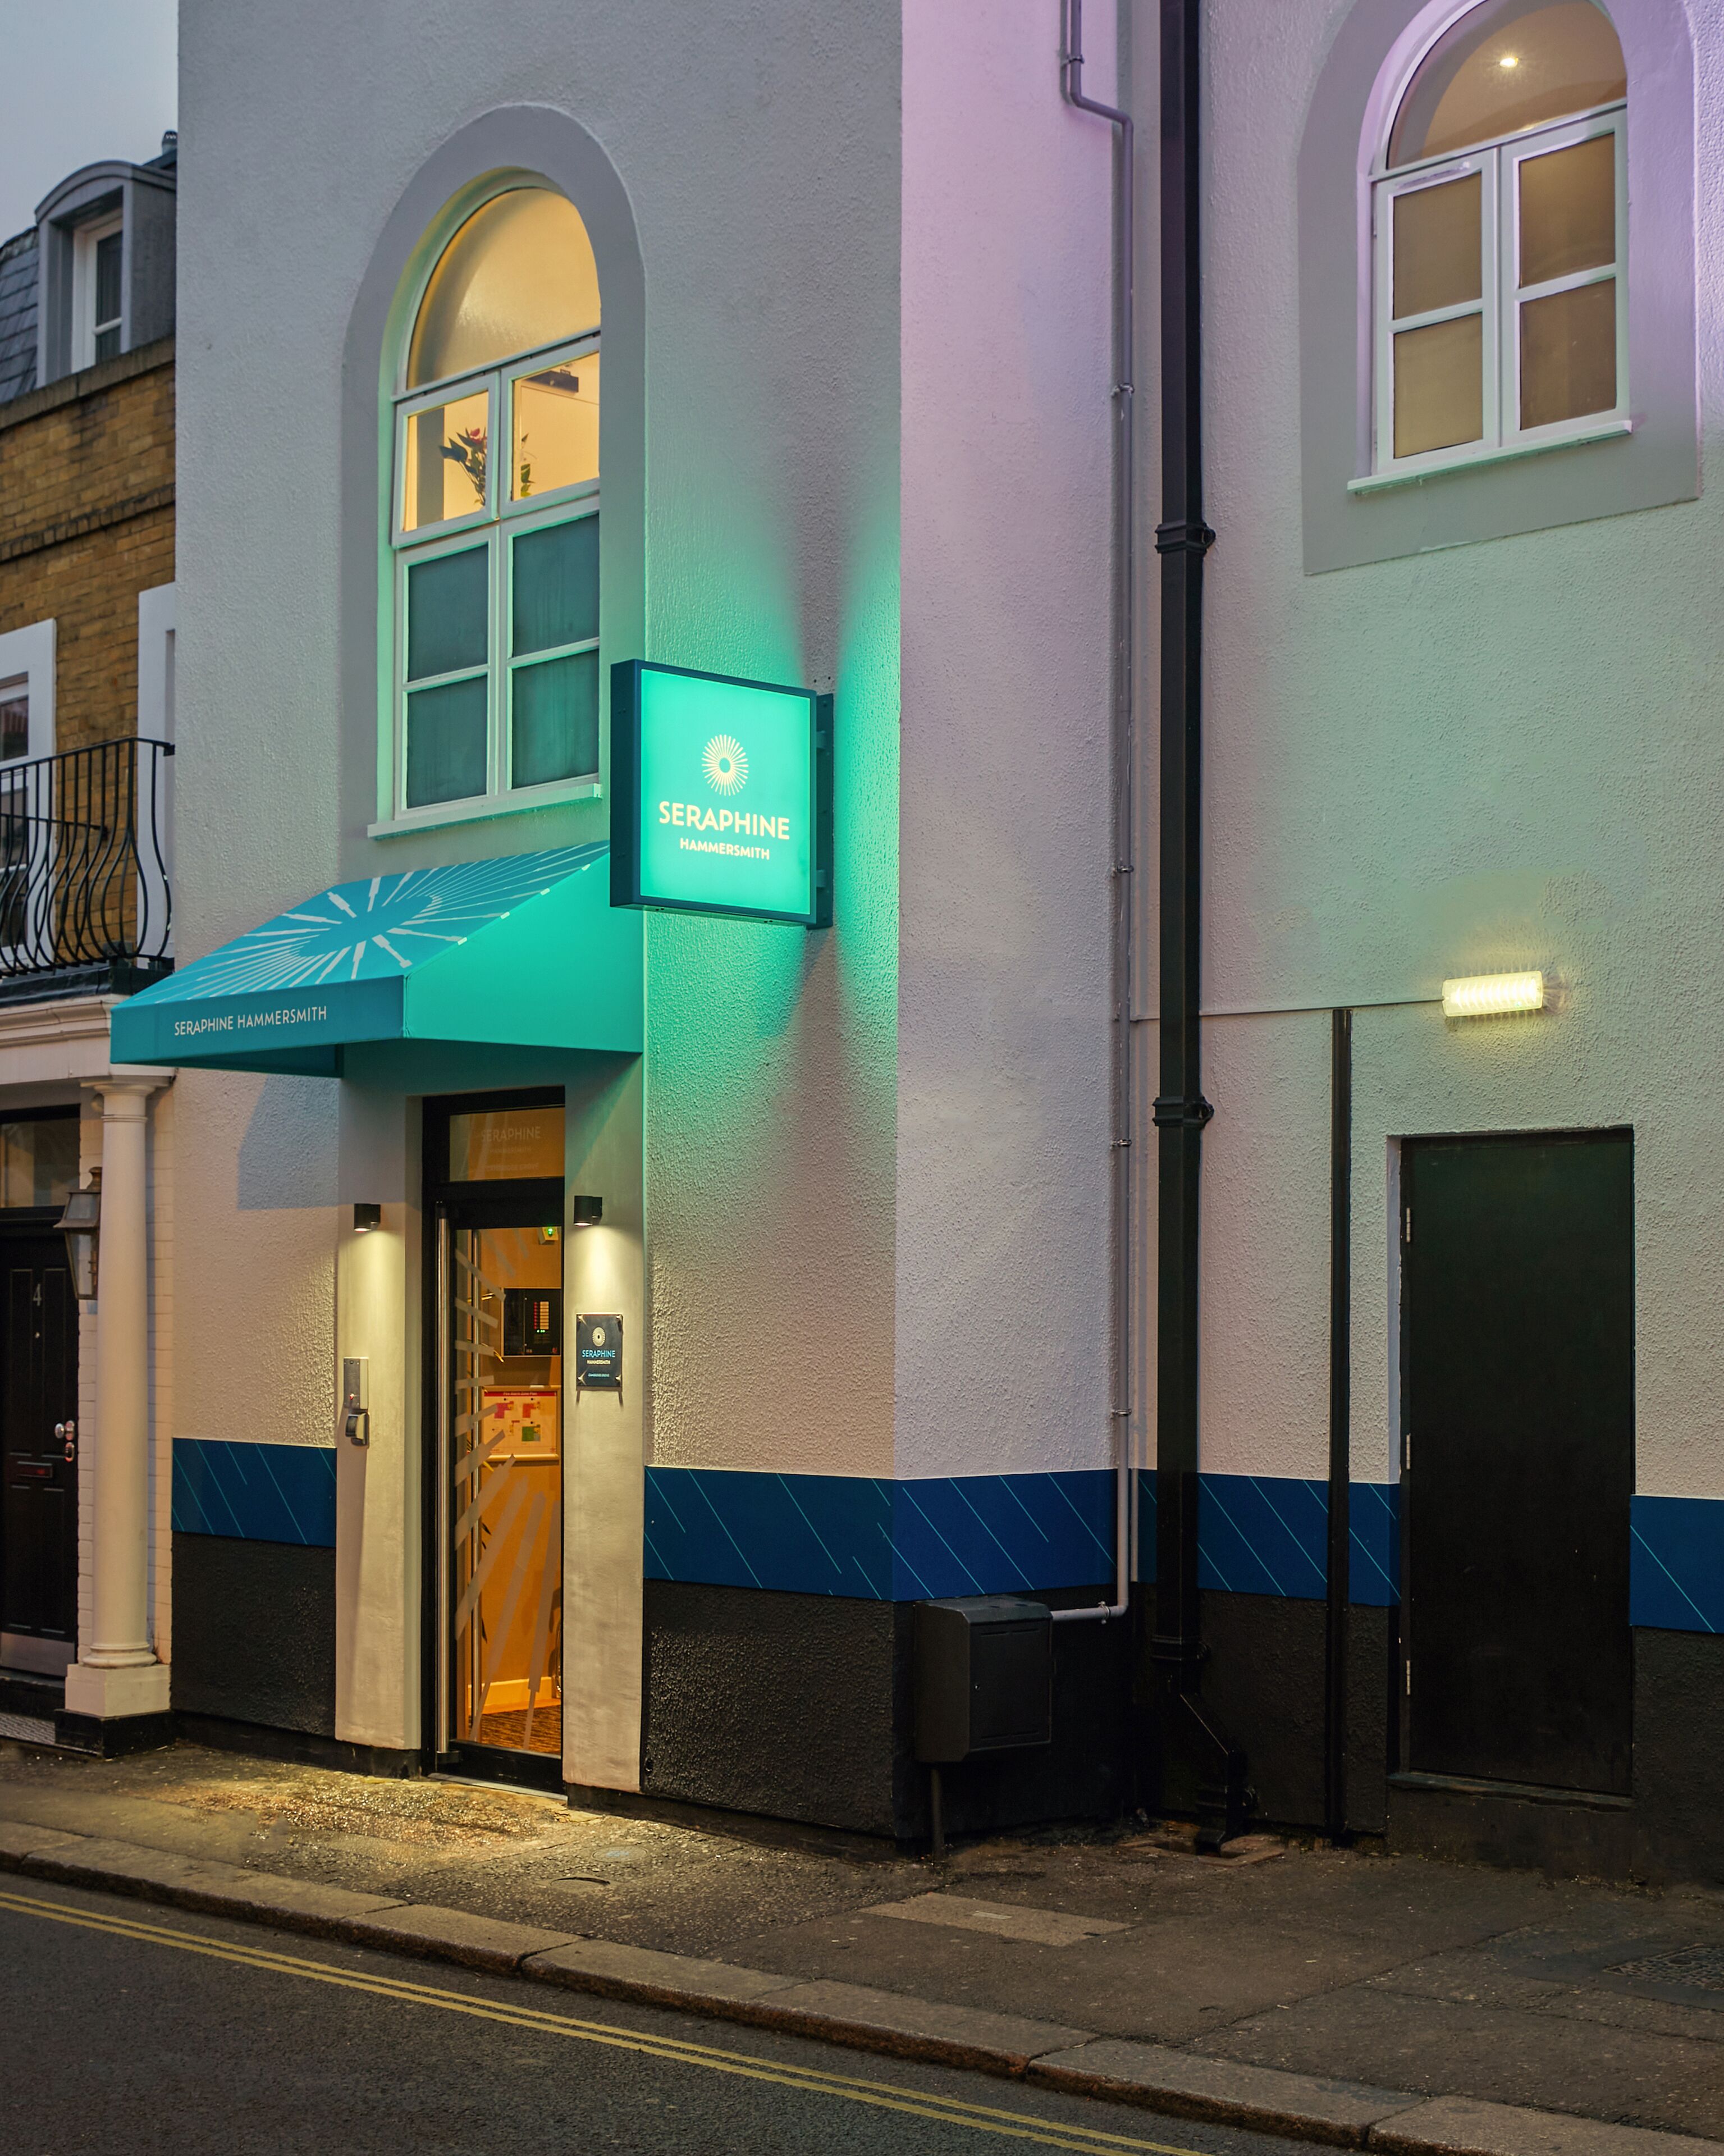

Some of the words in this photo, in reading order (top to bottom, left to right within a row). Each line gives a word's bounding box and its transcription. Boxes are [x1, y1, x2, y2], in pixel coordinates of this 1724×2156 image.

[659, 801, 790, 840] SERAPHINE
[680, 838, 770, 860] HAMMERSMITH
[175, 1016, 233, 1036] SERAPHINE
[237, 1006, 327, 1028] HAMMERSMITH
[481, 1126, 541, 1142] SERAPHINE
[33, 1283, 42, 1307] 4
[582, 1349, 616, 1358] SERAPHINE
